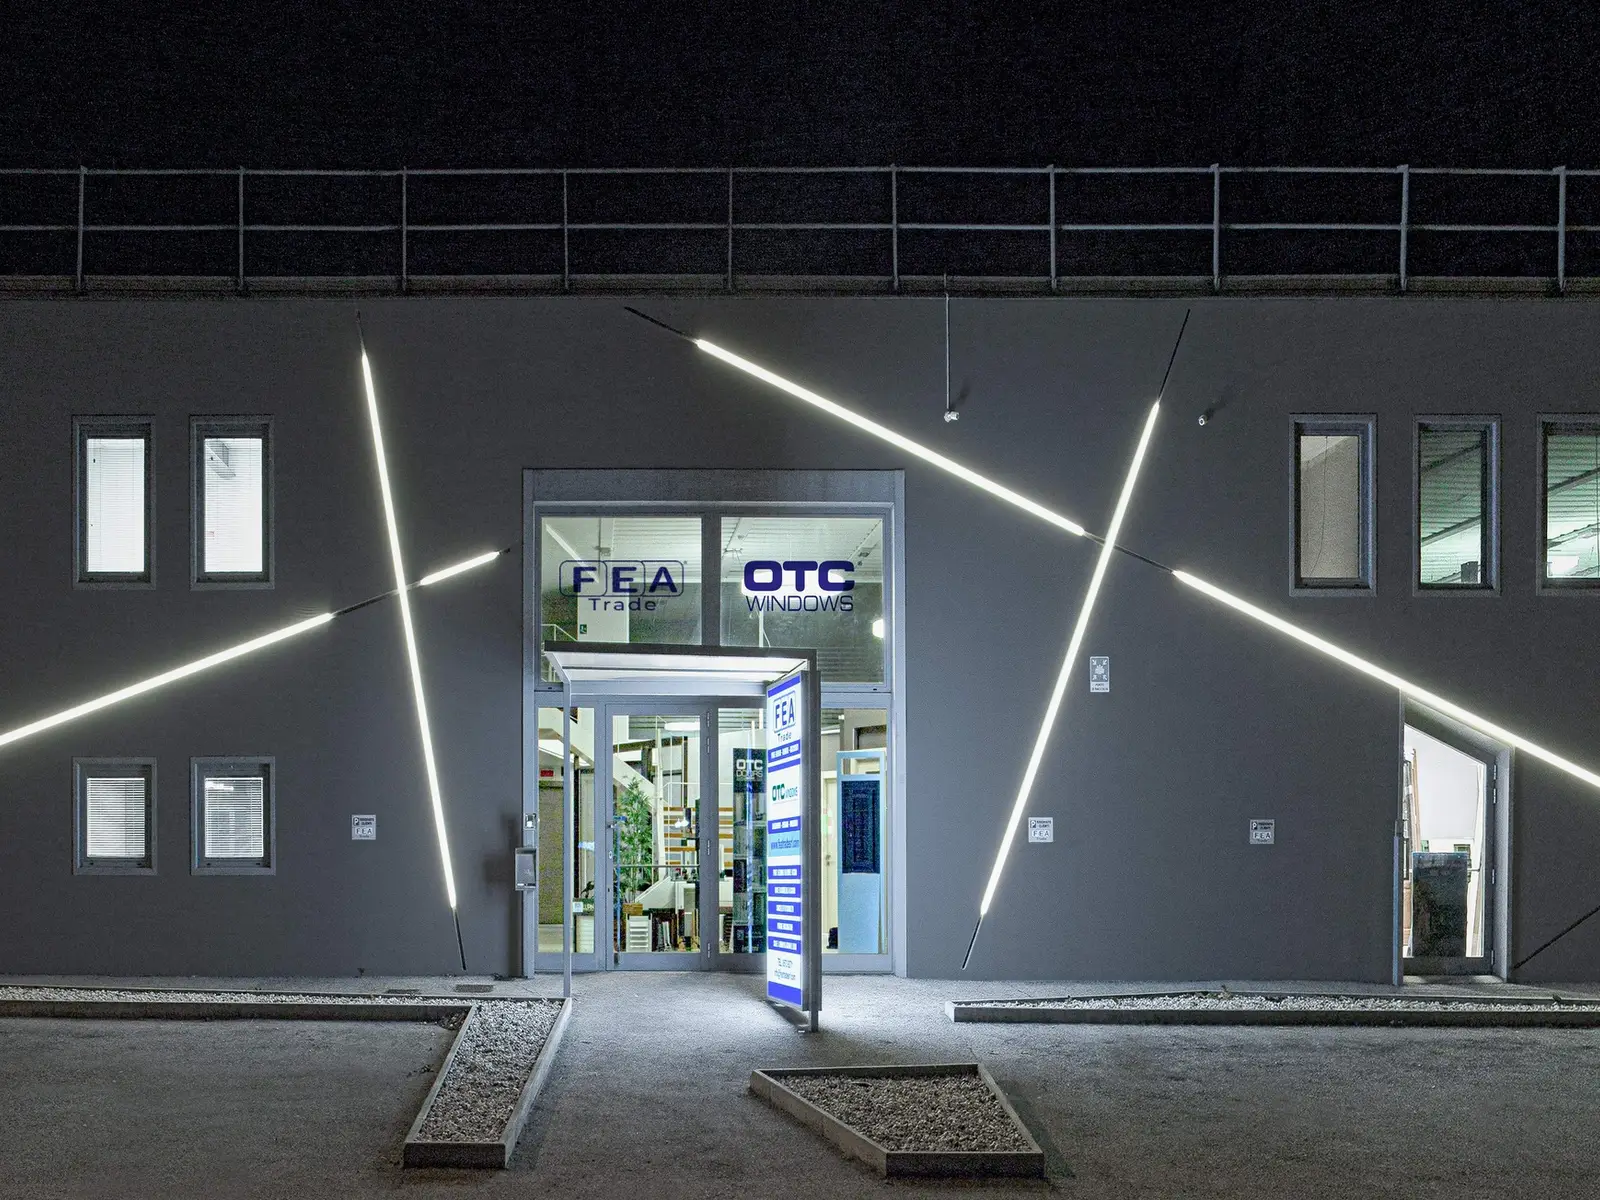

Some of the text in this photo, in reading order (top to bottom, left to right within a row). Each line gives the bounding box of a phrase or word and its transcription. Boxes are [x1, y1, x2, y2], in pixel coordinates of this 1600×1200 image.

[573, 566, 678, 593] FEA
[744, 560, 855, 592] OTC
[588, 598, 657, 611] Trade
[746, 595, 854, 612] WINDOWS
[775, 697, 795, 729] FEA
[736, 759, 764, 770] OTC
[772, 783, 785, 801] OTC
